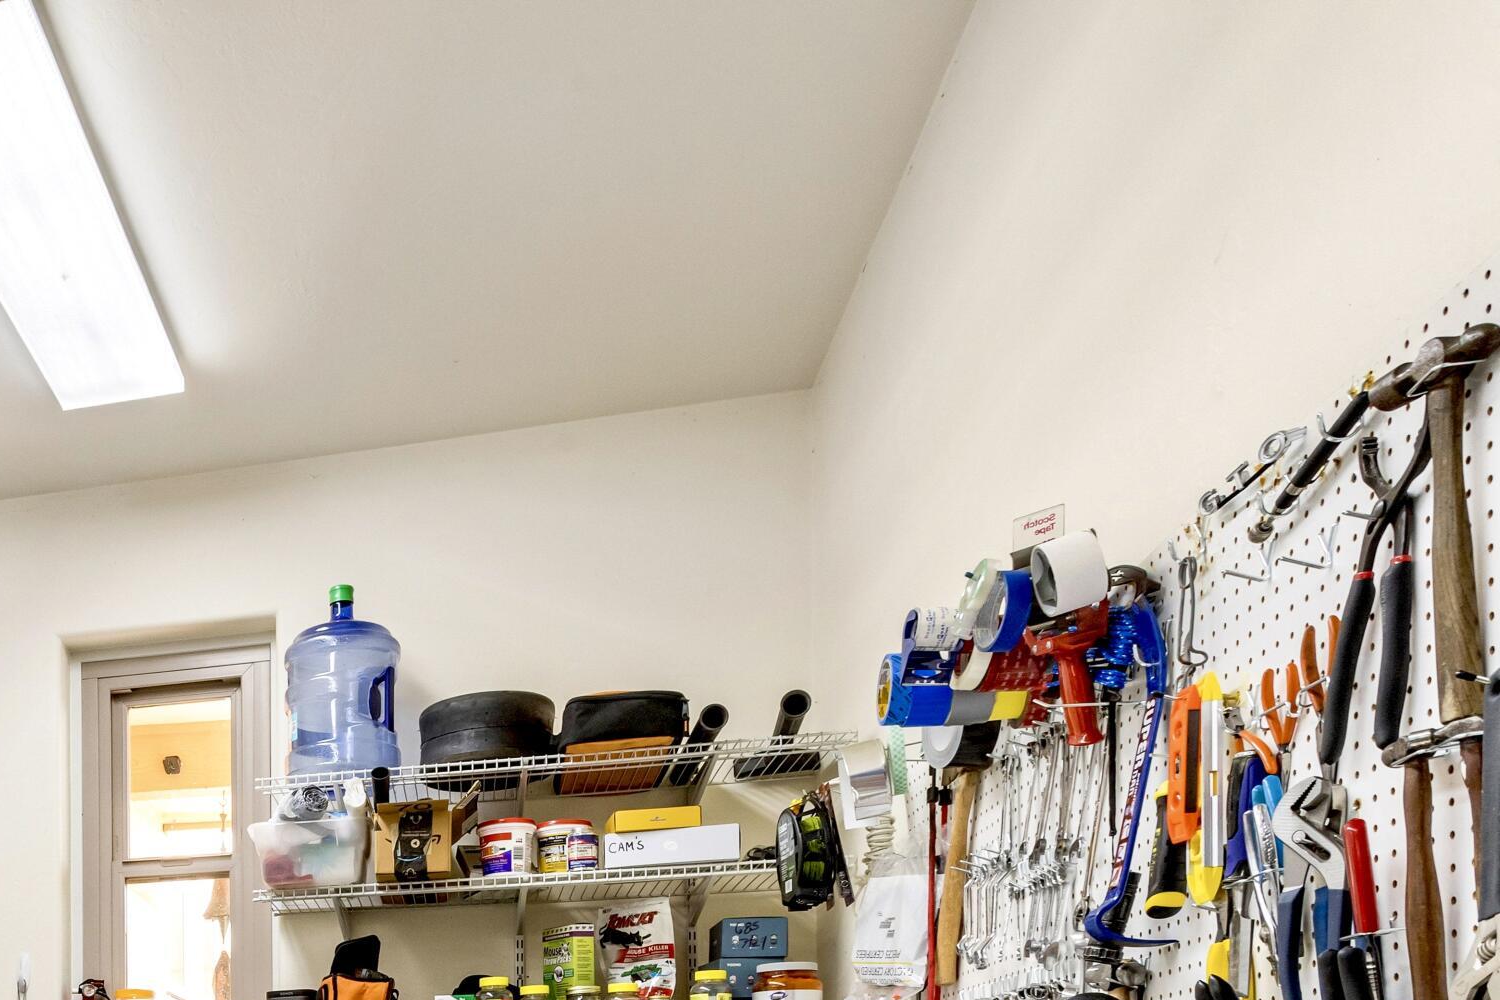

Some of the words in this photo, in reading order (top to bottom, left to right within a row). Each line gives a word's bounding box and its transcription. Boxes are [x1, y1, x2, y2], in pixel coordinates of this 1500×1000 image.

[608, 836, 644, 854] CAM'S
[543, 945, 563, 957] Mouse
[648, 945, 669, 953] KILLER
